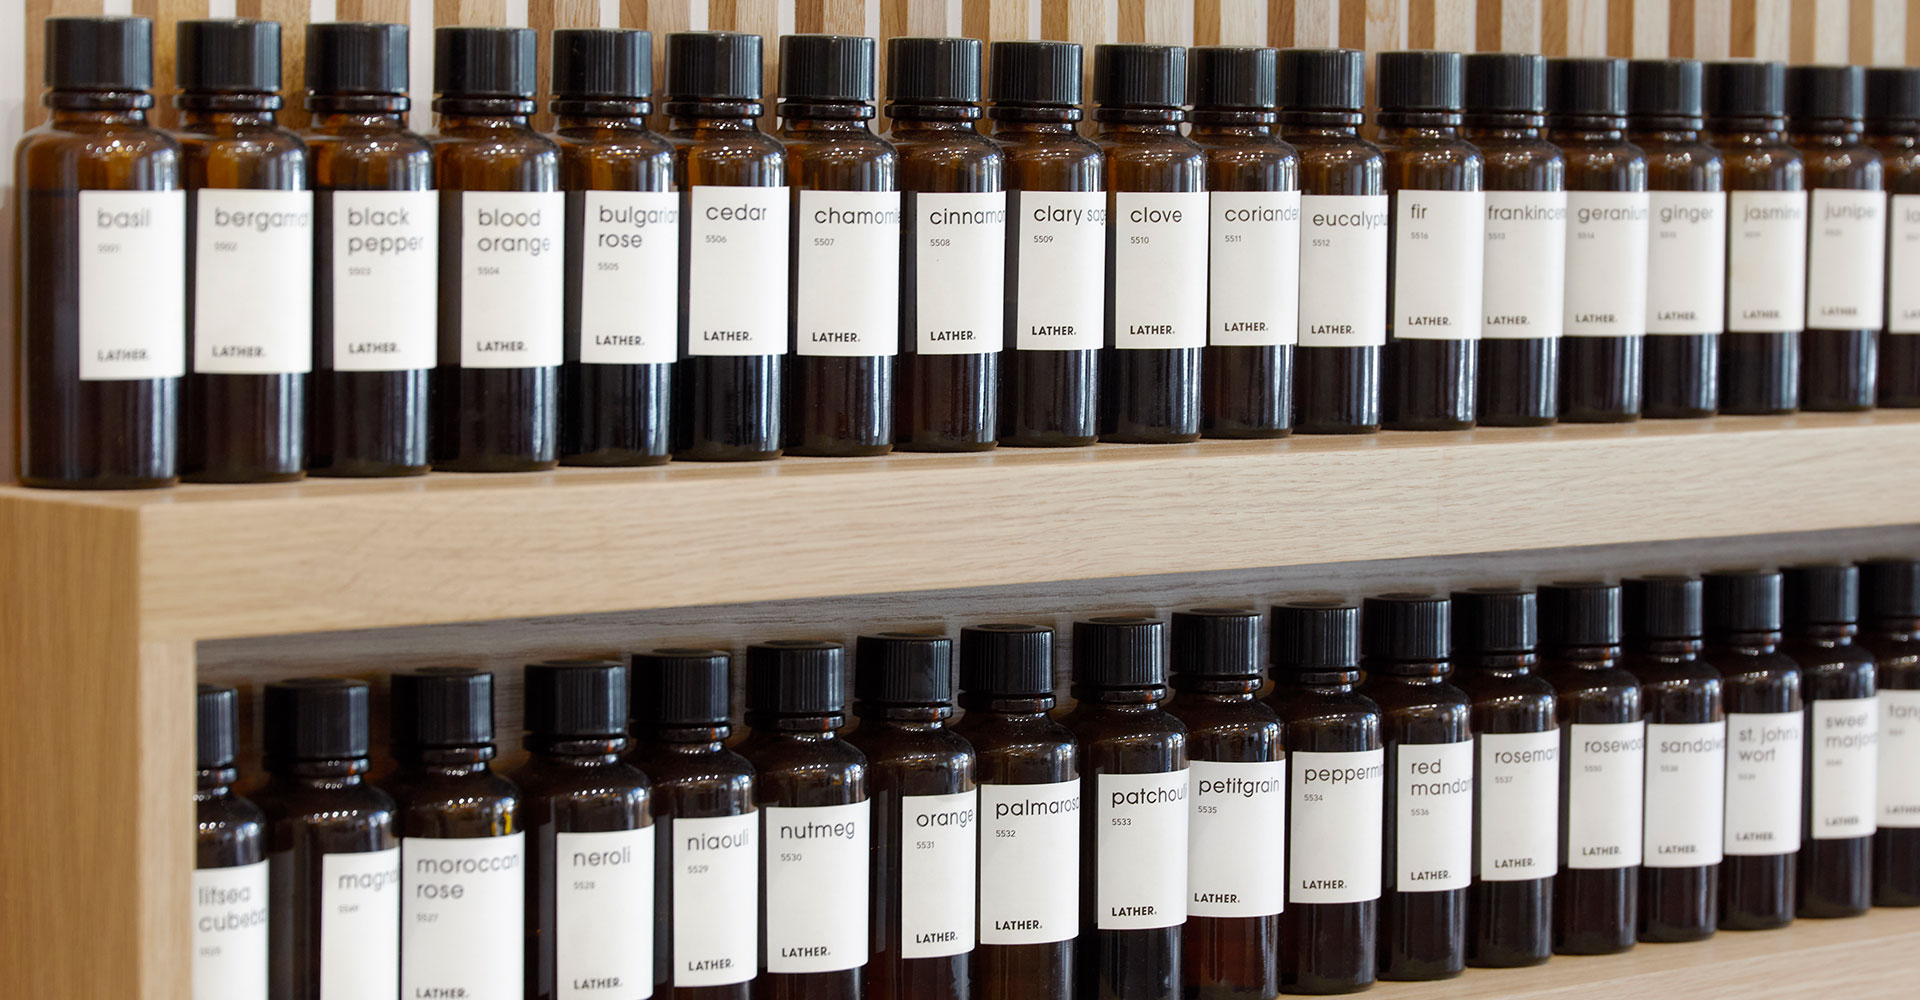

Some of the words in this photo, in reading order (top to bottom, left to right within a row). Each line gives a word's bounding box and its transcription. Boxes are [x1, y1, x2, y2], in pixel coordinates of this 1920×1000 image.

[98, 208, 150, 228] basil
[348, 208, 408, 226] black
[478, 208, 541, 227] blood
[706, 204, 767, 221] cedar
[1034, 206, 1082, 225] clary
[1131, 207, 1183, 223] clove
[1225, 206, 1299, 222] coriander
[1411, 203, 1427, 219] fir
[1660, 204, 1713, 223] ginger
[348, 235, 422, 254] pepper
[478, 236, 550, 256] orange
[598, 232, 642, 248] rose
[706, 235, 727, 243] 5506
[814, 238, 834, 246] 5507
[1034, 235, 1053, 243] 5509
[1131, 236, 1149, 244] 5510
[598, 263, 619, 271] 5505
[1826, 715, 1868, 728] sweet
[1740, 748, 1775, 762] wort
[1412, 759, 1441, 774] red
[1199, 776, 1280, 798] petitgrain
[1495, 776, 1513, 784] 5537
[1112, 784, 1188, 808] patchouli
[916, 807, 973, 828] orange
[1198, 806, 1217, 814] 5535
[1411, 808, 1429, 816] 5536
[781, 821, 855, 840] nutmeg
[687, 829, 748, 851] niaouli
[916, 841, 934, 849] 5531
[417, 853, 519, 874] moroccan
[574, 846, 631, 866] neroli
[781, 853, 802, 861] 5530
[688, 865, 708, 873] 5529
[199, 886, 250, 904] litsea
[417, 882, 463, 899] rose
